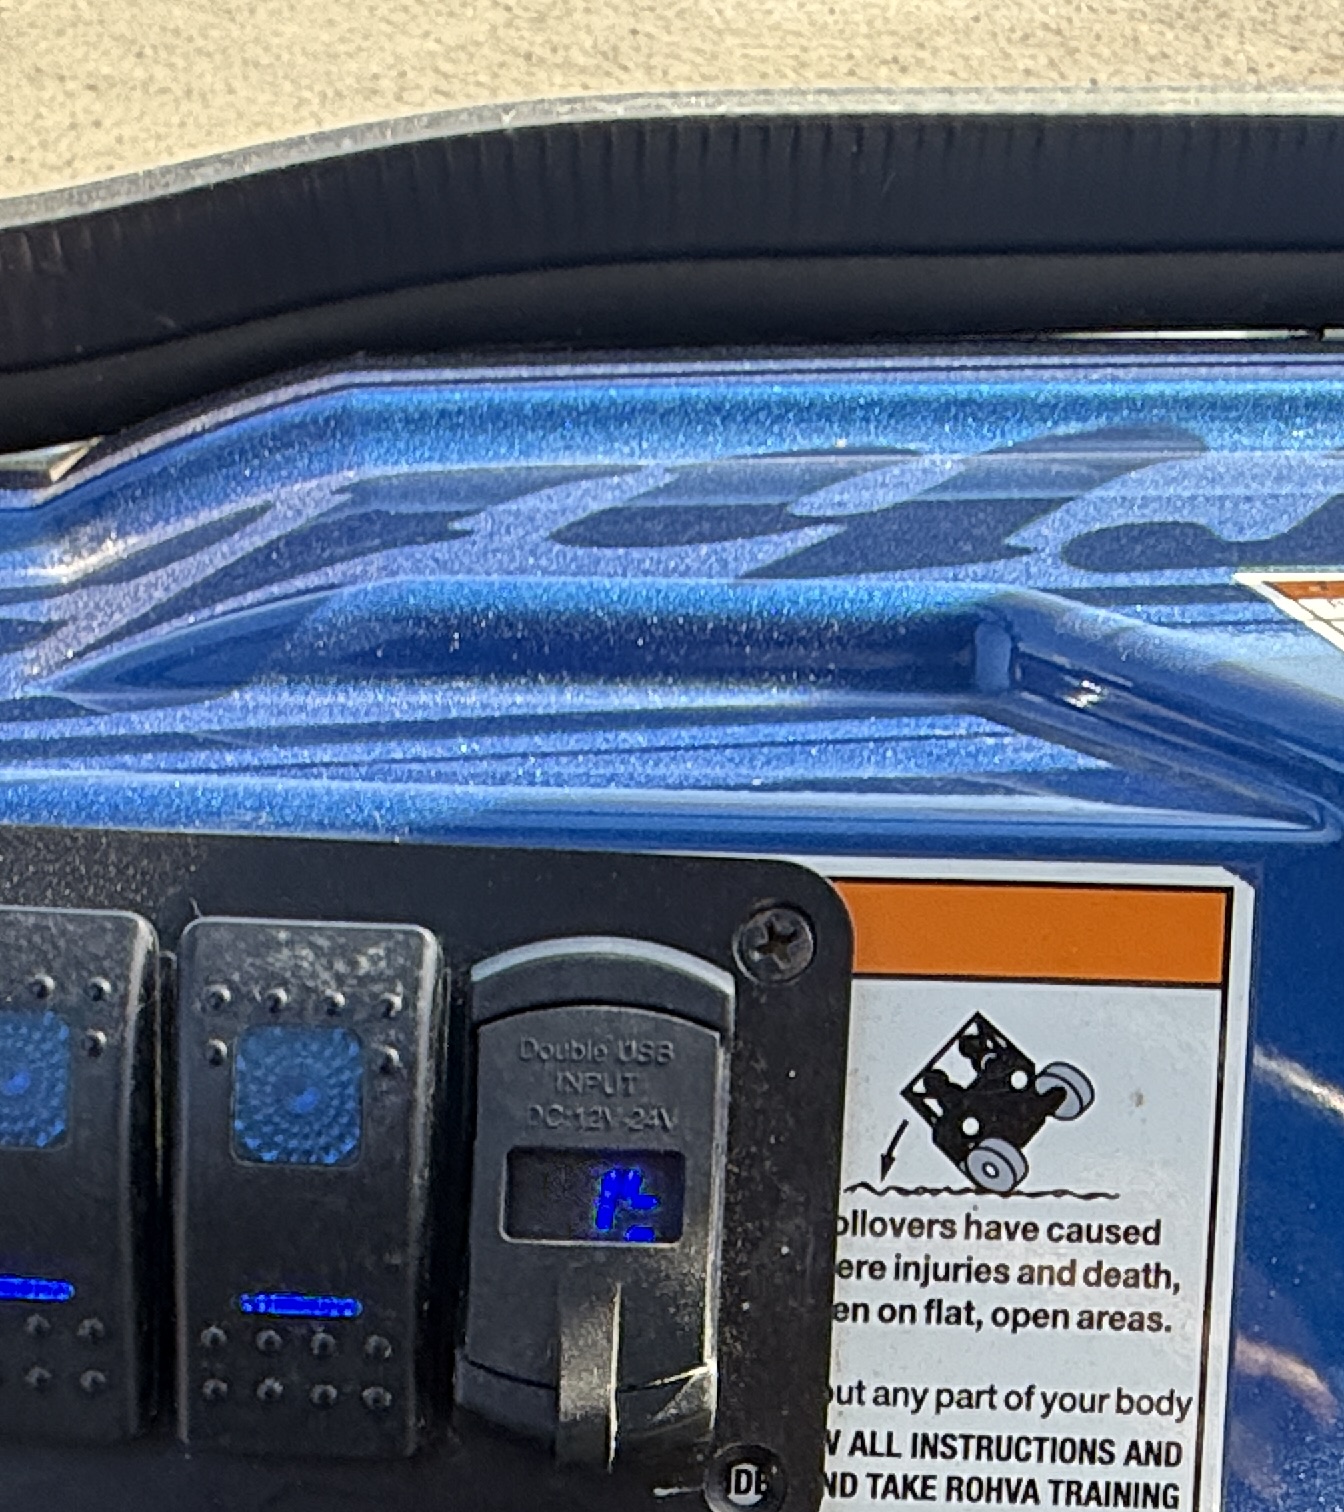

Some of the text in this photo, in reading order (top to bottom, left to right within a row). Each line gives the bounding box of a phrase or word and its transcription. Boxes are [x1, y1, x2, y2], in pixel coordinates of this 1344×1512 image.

[520, 1036, 676, 1065] Double USB
[556, 1071, 639, 1096] INPUT
[965, 1212, 1039, 1241] have
[1046, 1218, 1161, 1245] caused
[895, 1254, 1010, 1288] injuries
[1017, 1260, 1077, 1287] and
[1083, 1261, 1180, 1295] death,
[878, 1303, 917, 1326] on
[924, 1300, 985, 1333] flat,
[991, 1306, 1071, 1334] open
[1077, 1310, 1173, 1333] areas.
[872, 1387, 929, 1414] any
[935, 1384, 997, 1415] part
[1004, 1385, 1036, 1411] of
[1041, 1392, 1111, 1420] your
[1115, 1387, 1193, 1423] body
[848, 1431, 902, 1459] ALL
[911, 1433, 1115, 1465] INSTRUCTIONS
[1123, 1440, 1182, 1467] AND
[866, 1473, 936, 1501] TAKE
[946, 1476, 1040, 1504] ROHVA
[1048, 1479, 1180, 1510] TRAINING
